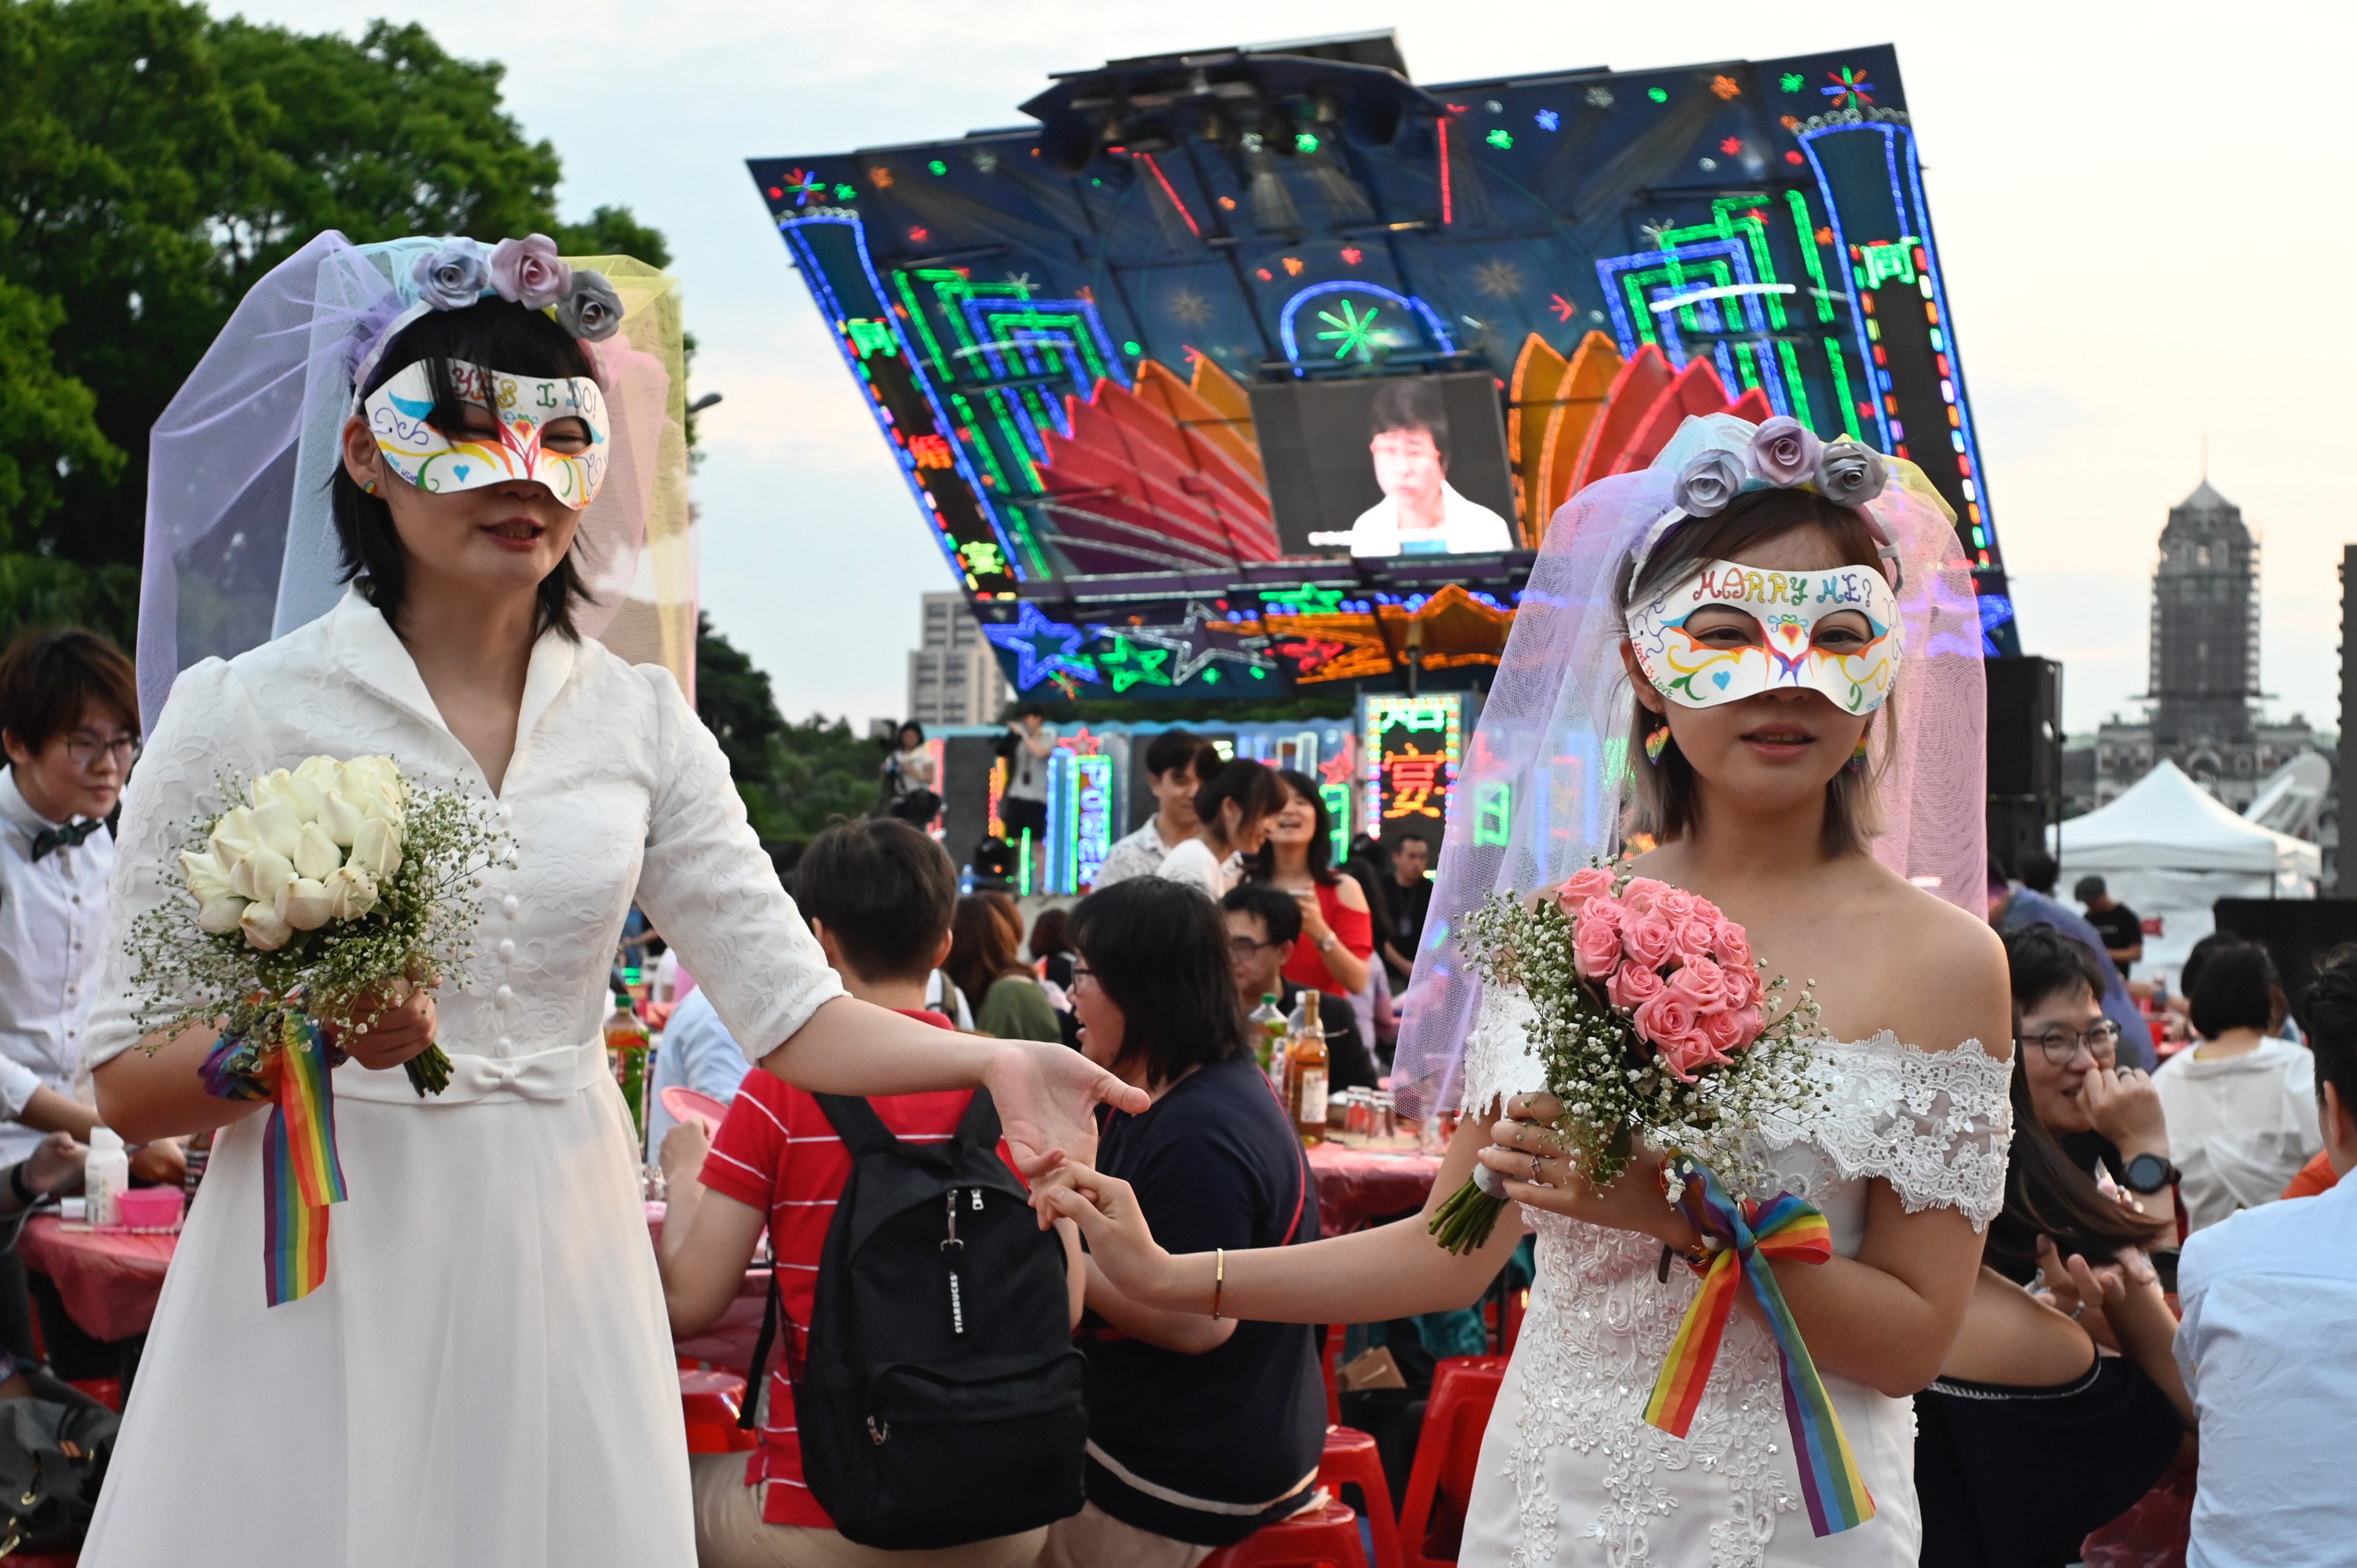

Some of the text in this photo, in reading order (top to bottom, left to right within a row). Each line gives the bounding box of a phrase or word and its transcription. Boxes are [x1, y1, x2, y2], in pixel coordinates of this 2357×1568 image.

[452, 366, 597, 418] YES I DO!
[1692, 567, 1872, 608] MARRY ME?
[1633, 642, 1673, 698] LOVE IS LOVE
[949, 1273, 964, 1333] STARBUCKS
